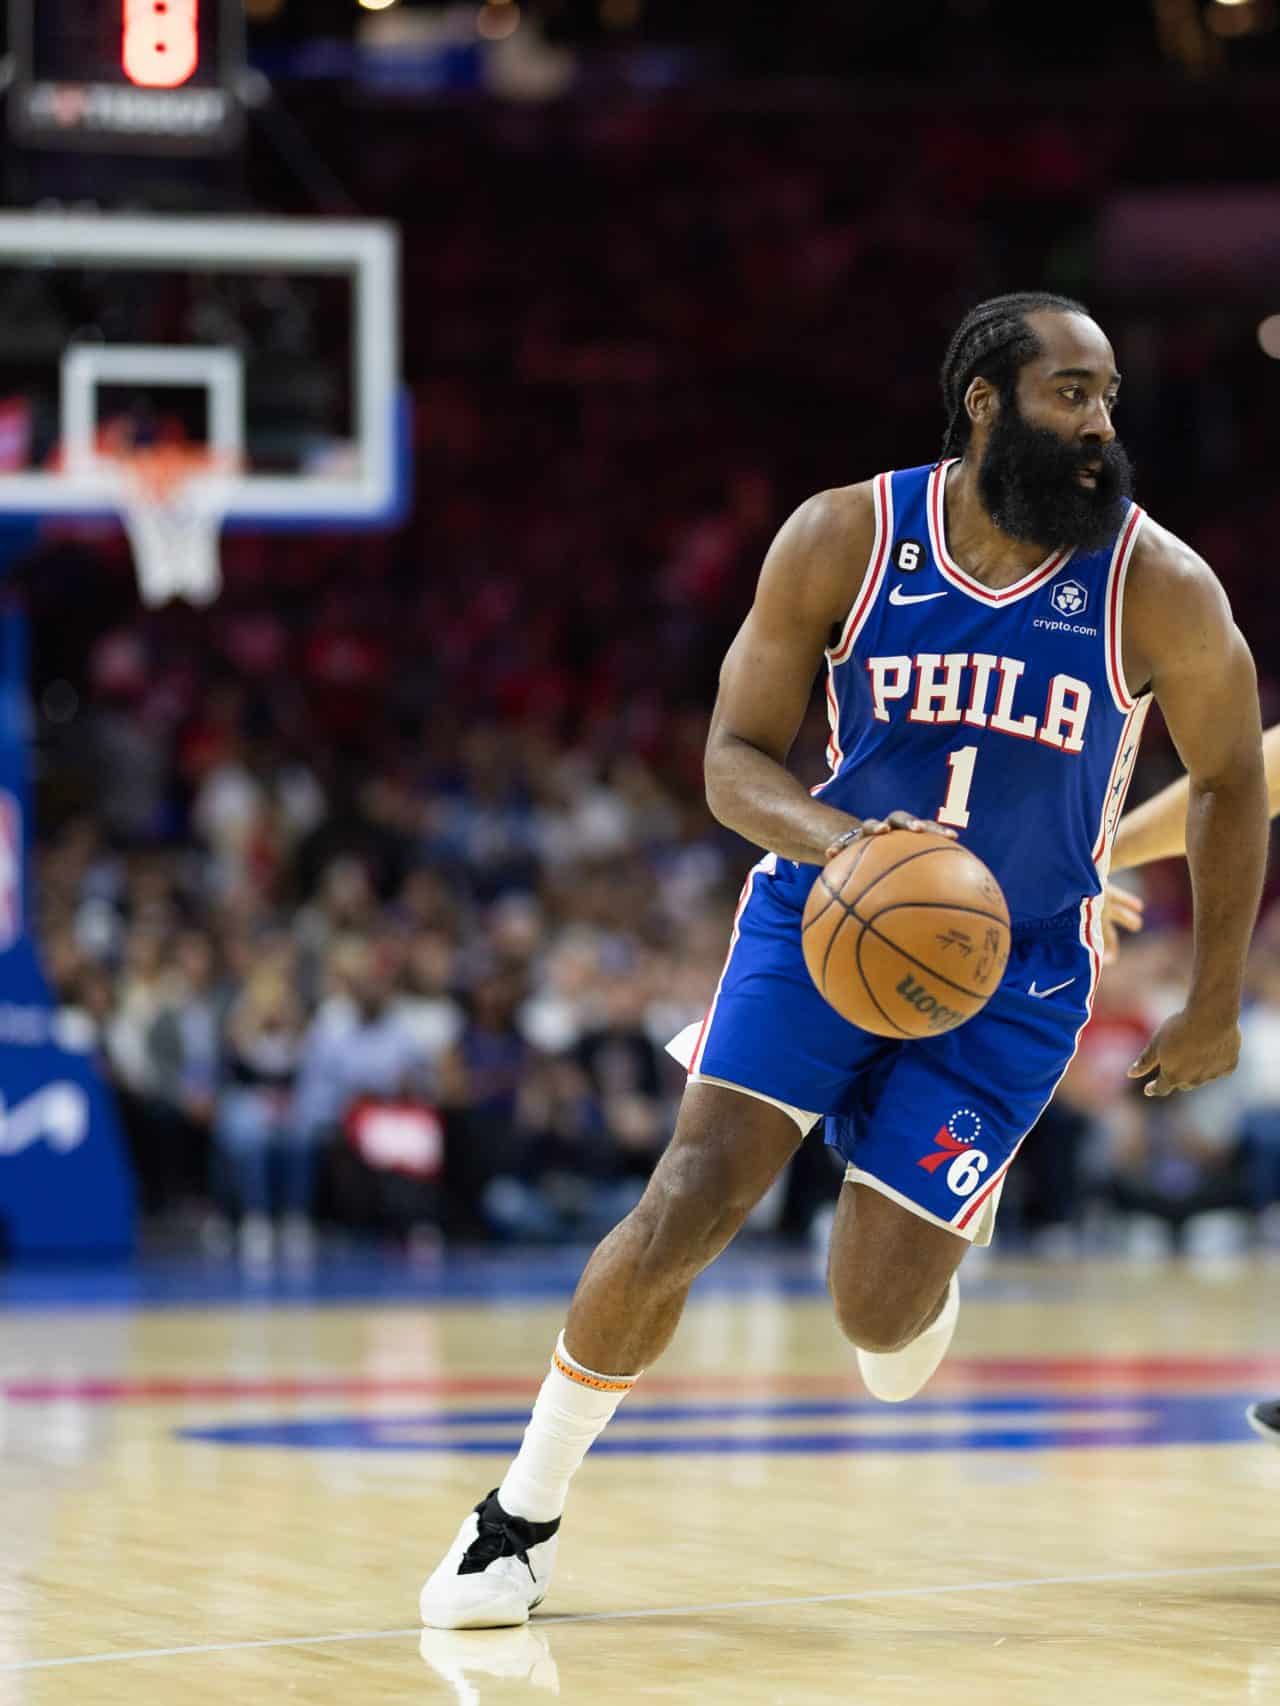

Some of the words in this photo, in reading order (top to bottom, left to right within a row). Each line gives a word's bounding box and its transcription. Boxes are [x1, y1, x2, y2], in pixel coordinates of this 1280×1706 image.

[899, 543, 920, 570] 6
[1032, 617, 1097, 637] crypto.com
[867, 652, 1092, 753] PHILA
[936, 745, 978, 828] 1
